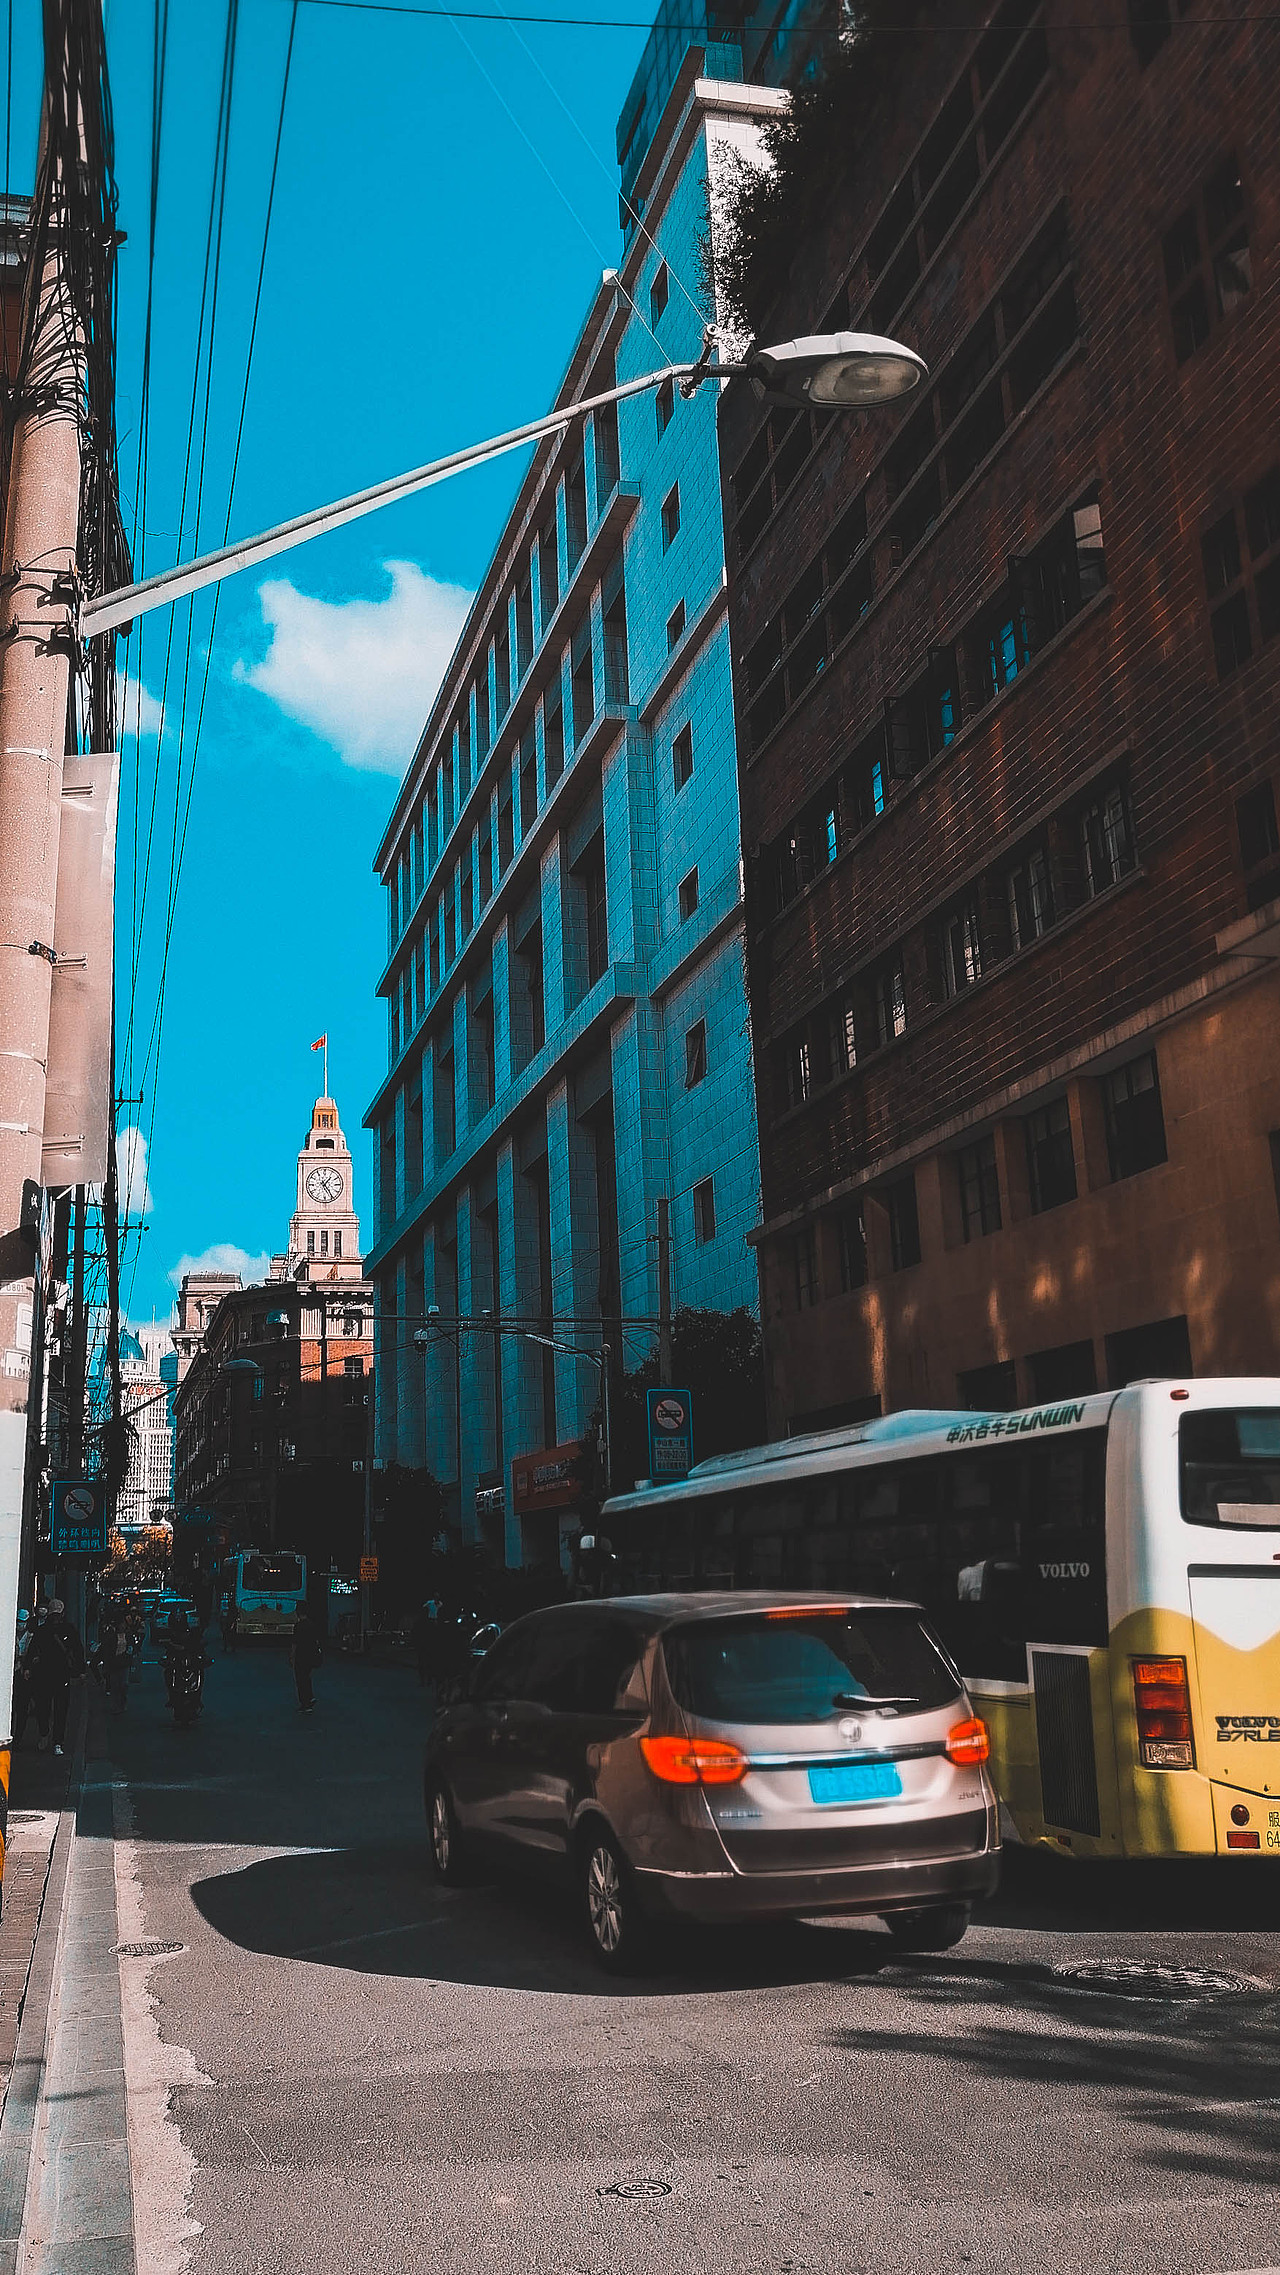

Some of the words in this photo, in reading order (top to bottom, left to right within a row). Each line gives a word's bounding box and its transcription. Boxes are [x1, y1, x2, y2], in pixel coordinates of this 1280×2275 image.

[946, 1417, 1007, 1443] 申沃客车
[1005, 1403, 1087, 1435] SUNWIN
[1038, 1562, 1090, 1578] VOLVO
[1215, 1716, 1280, 1729] VOLVO
[1217, 1730, 1280, 1742] B7RLE
